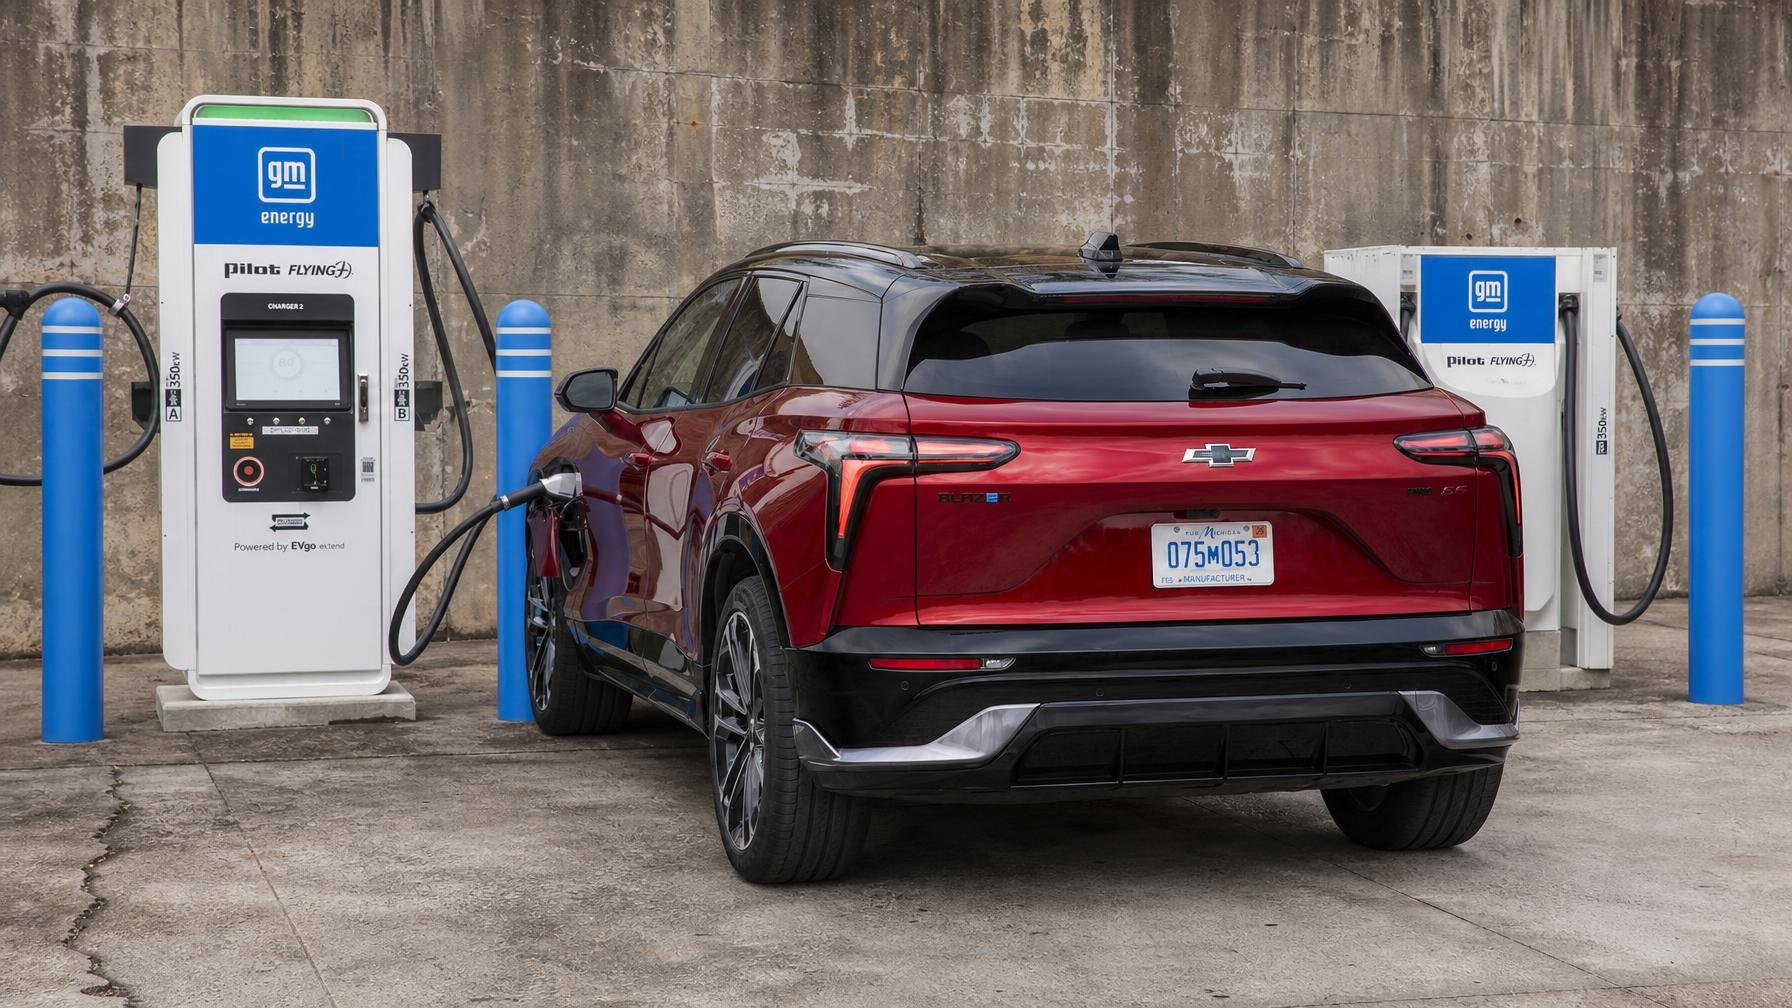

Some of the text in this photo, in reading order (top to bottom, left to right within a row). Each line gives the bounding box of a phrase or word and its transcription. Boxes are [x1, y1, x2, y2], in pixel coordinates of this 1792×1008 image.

[267, 160, 306, 190] gm
[261, 211, 315, 229] energy
[224, 262, 281, 279] Pilot
[1475, 280, 1501, 302] gm
[267, 302, 304, 310] CHARGER 2
[1470, 318, 1507, 332] energy
[1446, 355, 1485, 368] Pilot
[168, 408, 179, 420] A
[398, 408, 407, 419] B
[234, 542, 274, 551] Powered
[277, 542, 289, 552] by
[291, 541, 317, 552] EVgo
[1167, 539, 1260, 569] 075M053
[1183, 574, 1246, 583] MANUFACTURER
